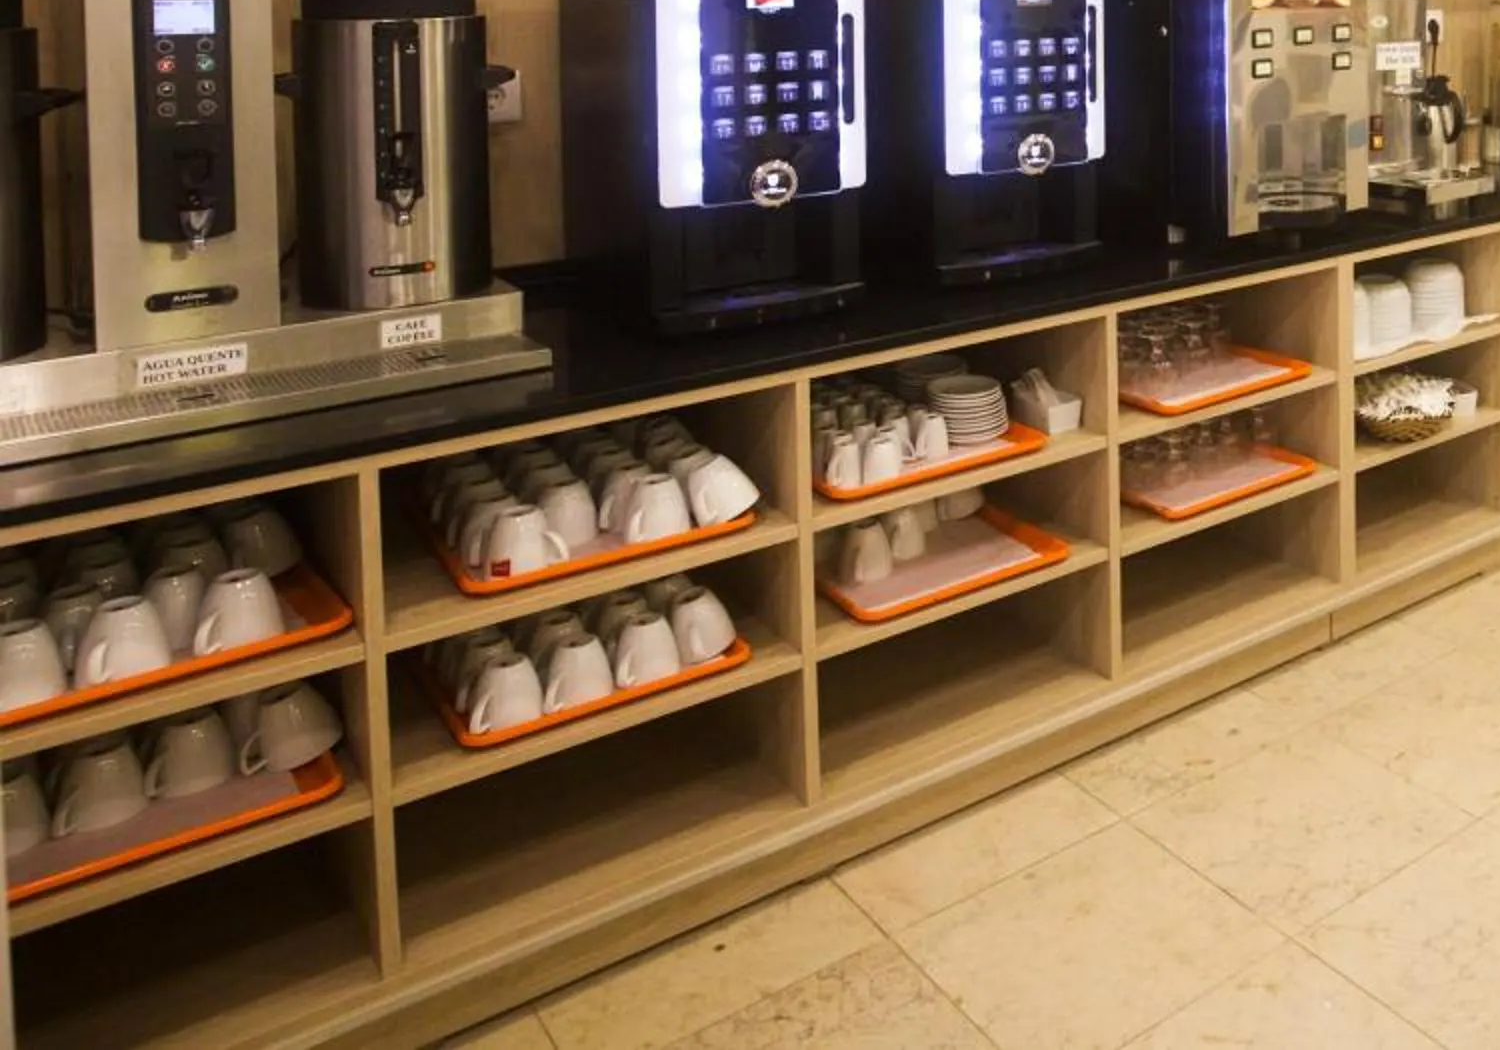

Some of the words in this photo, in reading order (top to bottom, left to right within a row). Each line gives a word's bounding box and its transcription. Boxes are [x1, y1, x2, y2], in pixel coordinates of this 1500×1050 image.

[187, 349, 243, 365] QUENTE
[143, 371, 174, 385] HOT
[177, 363, 227, 378] WATER
